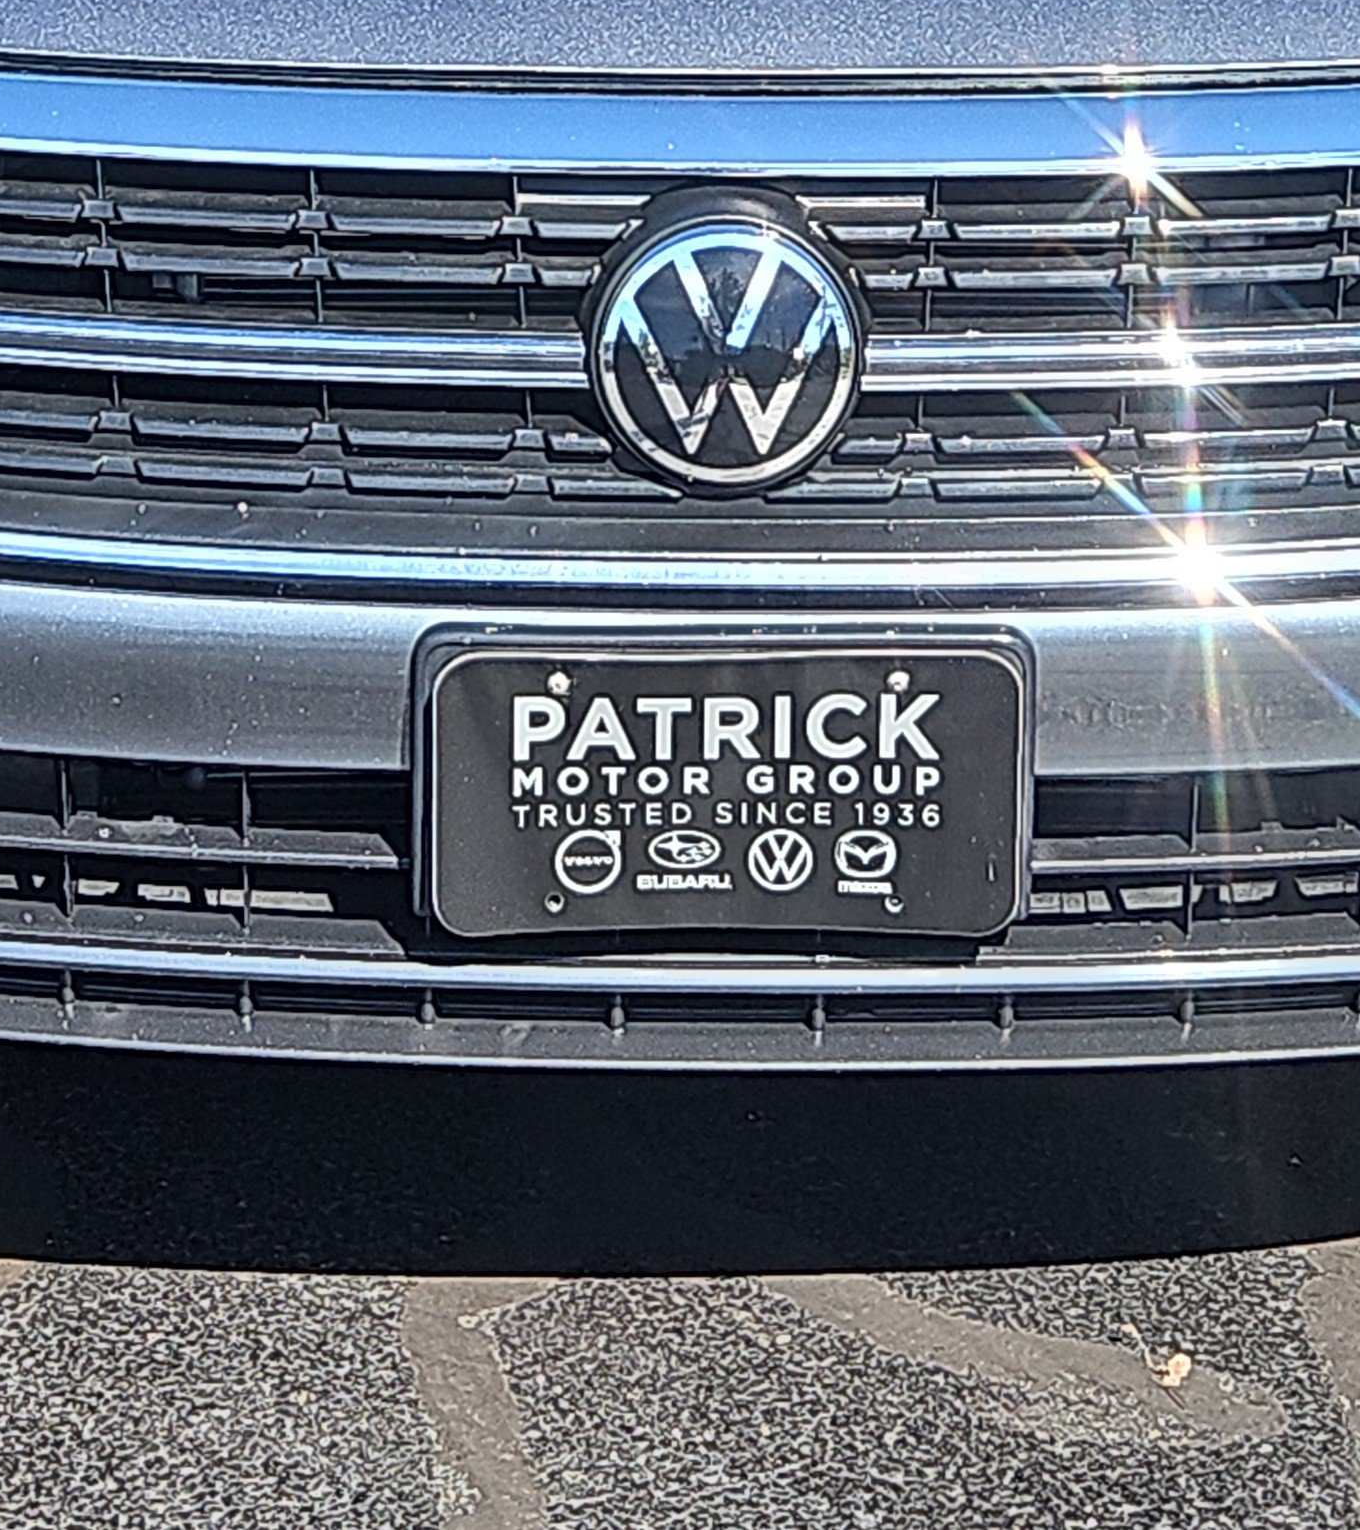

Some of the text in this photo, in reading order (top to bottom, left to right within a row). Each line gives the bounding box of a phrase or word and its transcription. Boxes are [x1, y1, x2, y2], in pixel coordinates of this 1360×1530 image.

[513, 693, 940, 762] PATRICK
[512, 764, 941, 798] MOTOR GROUP
[512, 801, 941, 829] TRUSTED SINCE 1936
[636, 874, 733, 890] SUBARU
